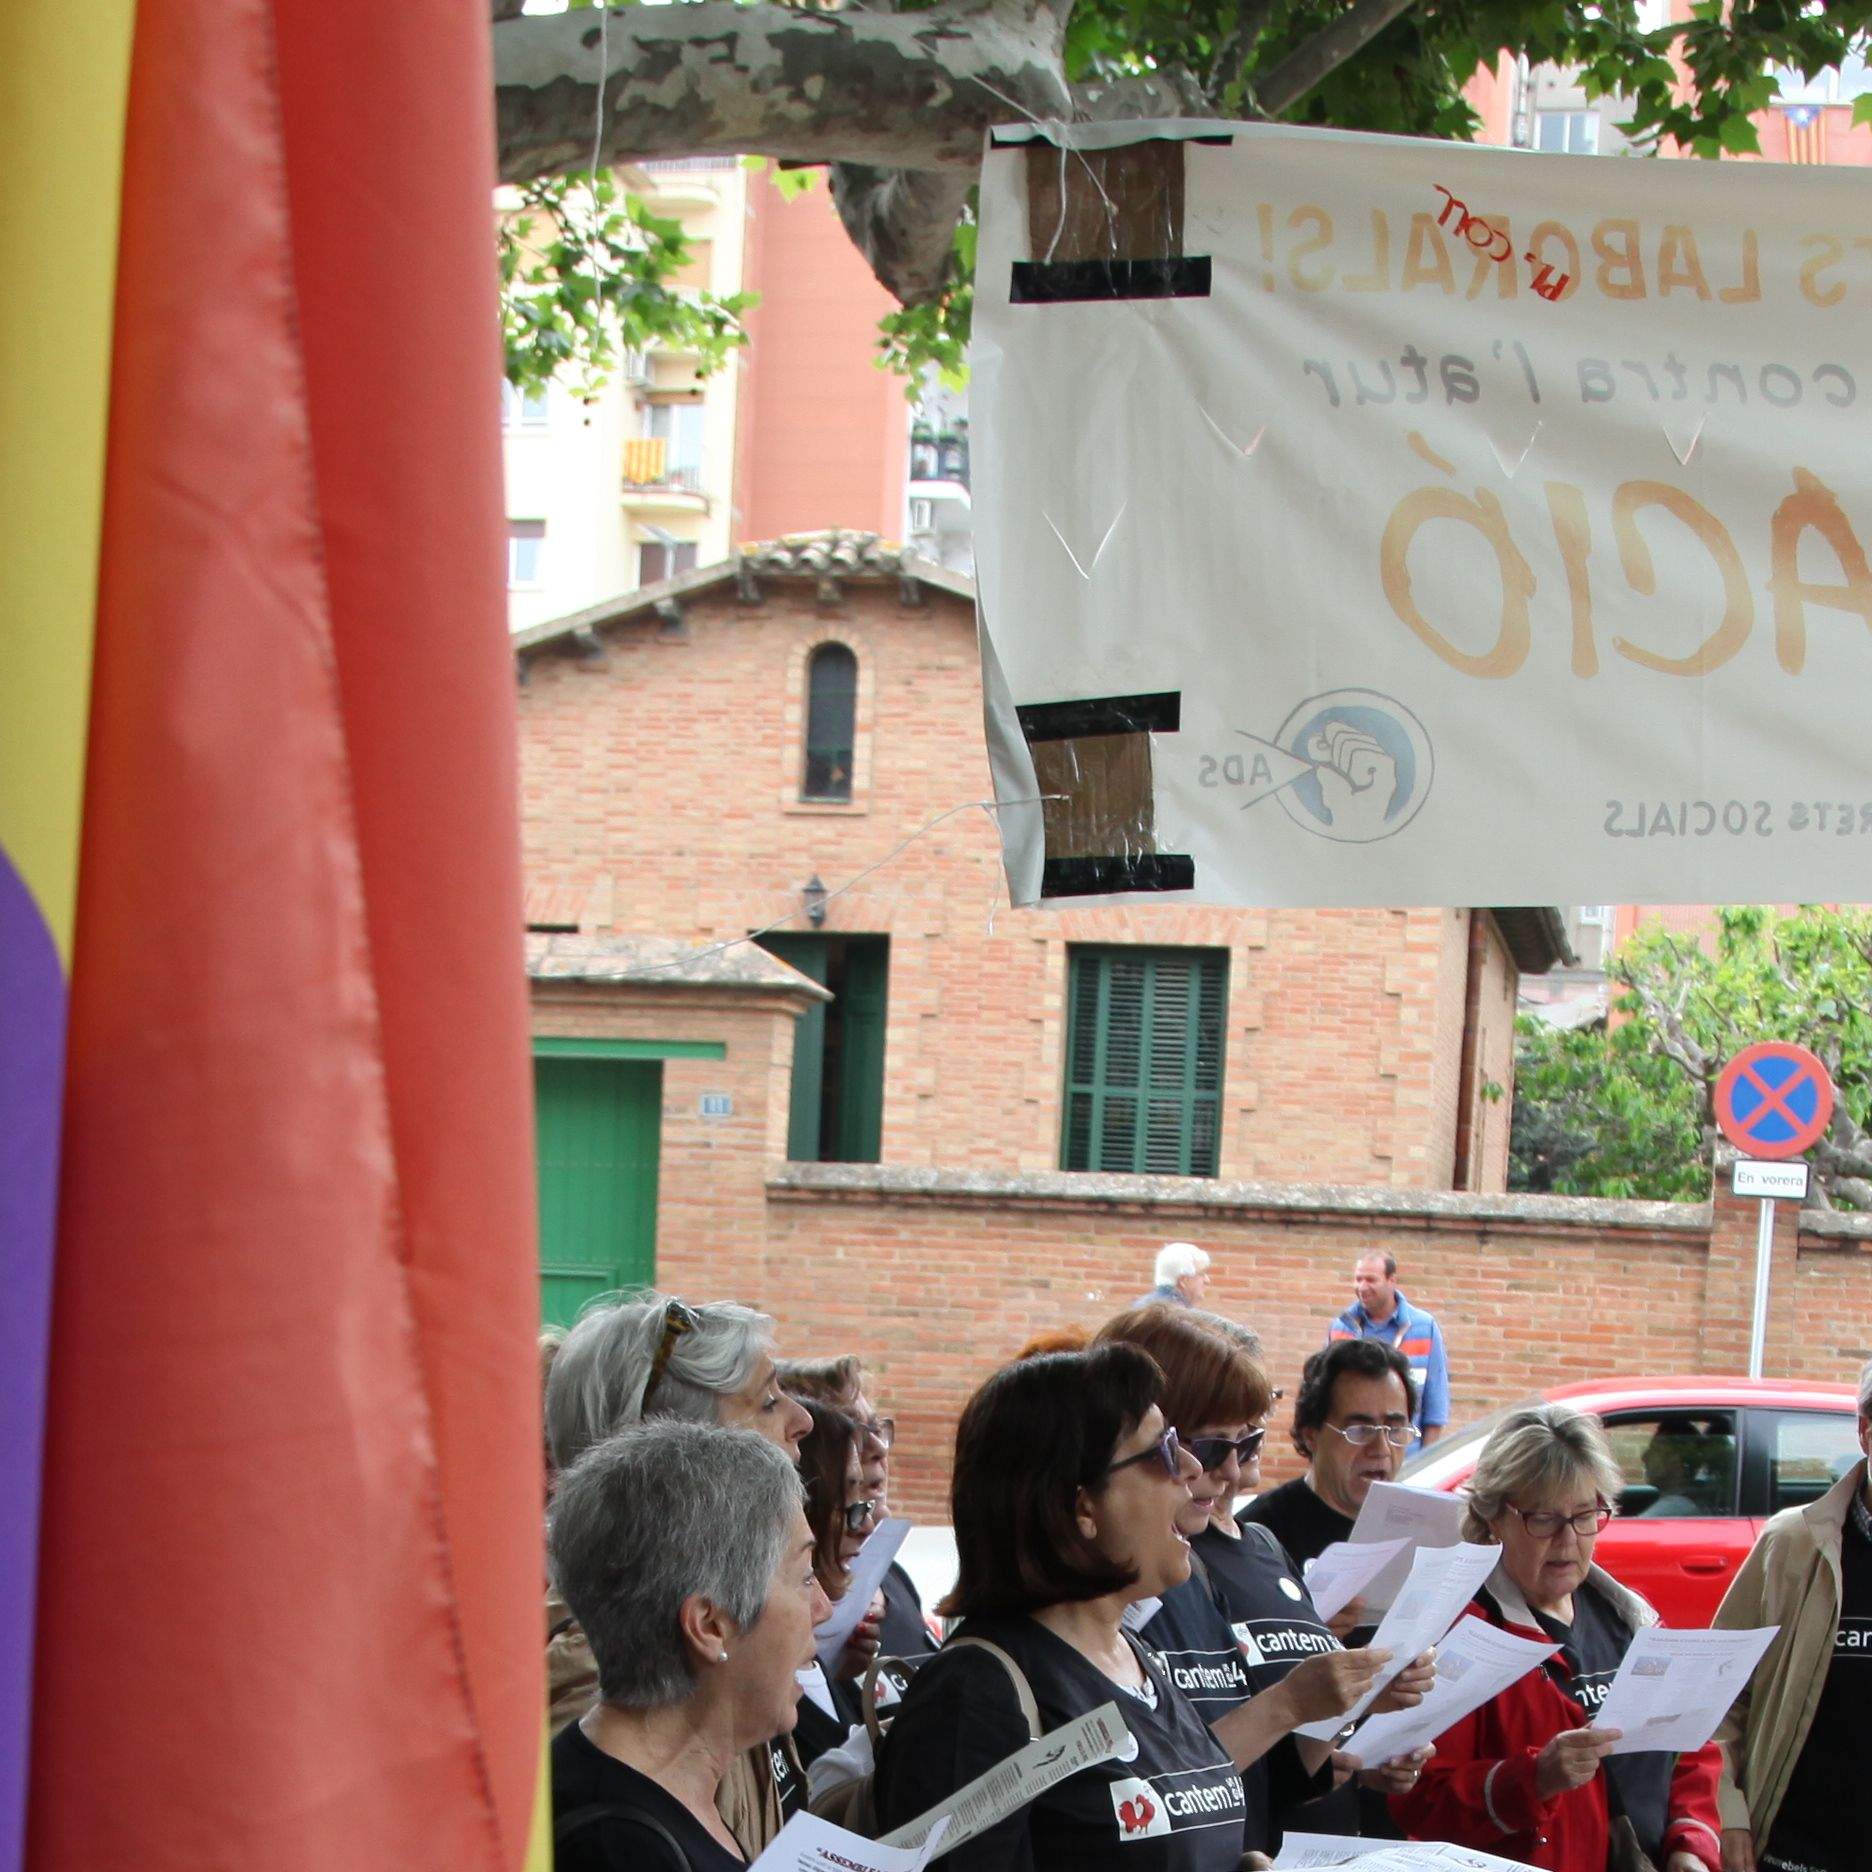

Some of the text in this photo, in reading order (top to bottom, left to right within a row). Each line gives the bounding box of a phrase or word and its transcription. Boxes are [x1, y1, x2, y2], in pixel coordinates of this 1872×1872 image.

[1761, 1175, 1804, 1187] vorera
[1255, 1628, 1329, 1653] cantem
[1164, 1782, 1233, 1817] cantem
